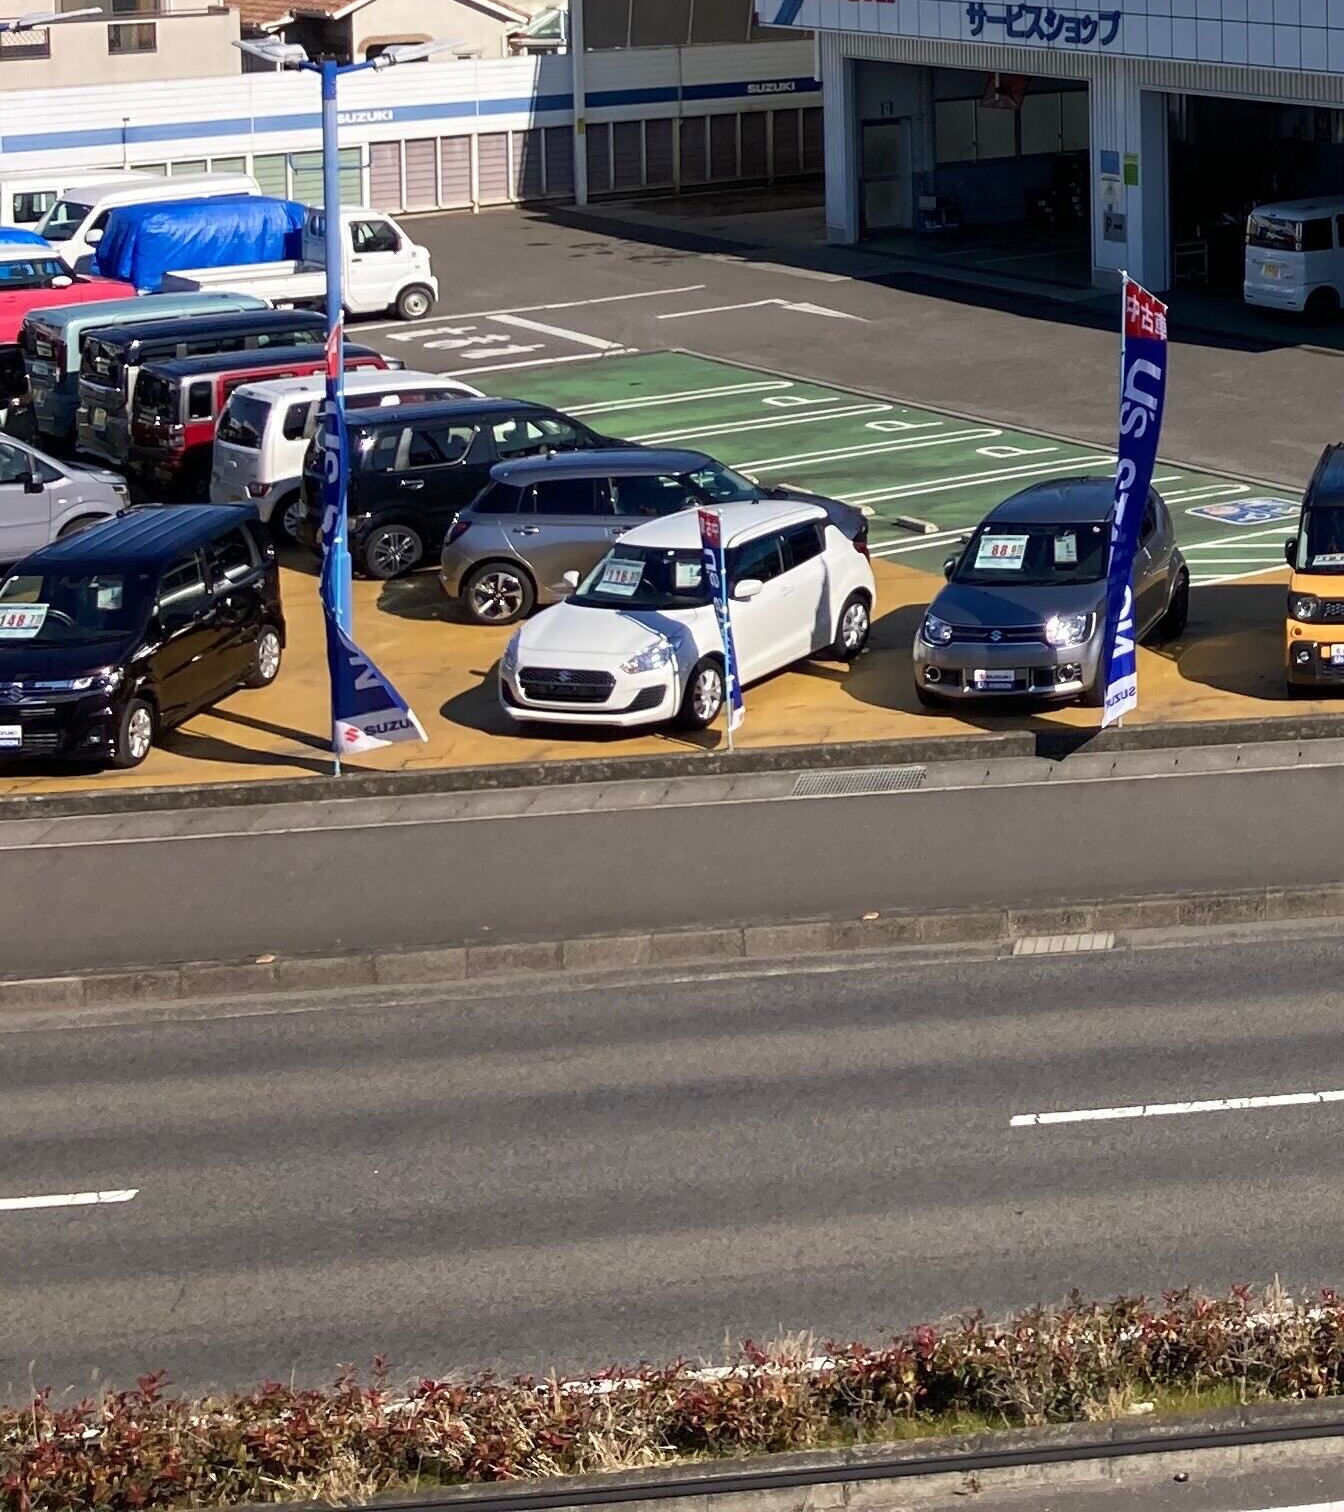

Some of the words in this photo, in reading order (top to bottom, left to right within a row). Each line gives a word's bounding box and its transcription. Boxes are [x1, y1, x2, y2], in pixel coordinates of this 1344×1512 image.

[966, 2, 1121, 45] サービスショップ
[747, 81, 796, 94] SUZUKI
[1126, 294, 1168, 340] 中古車
